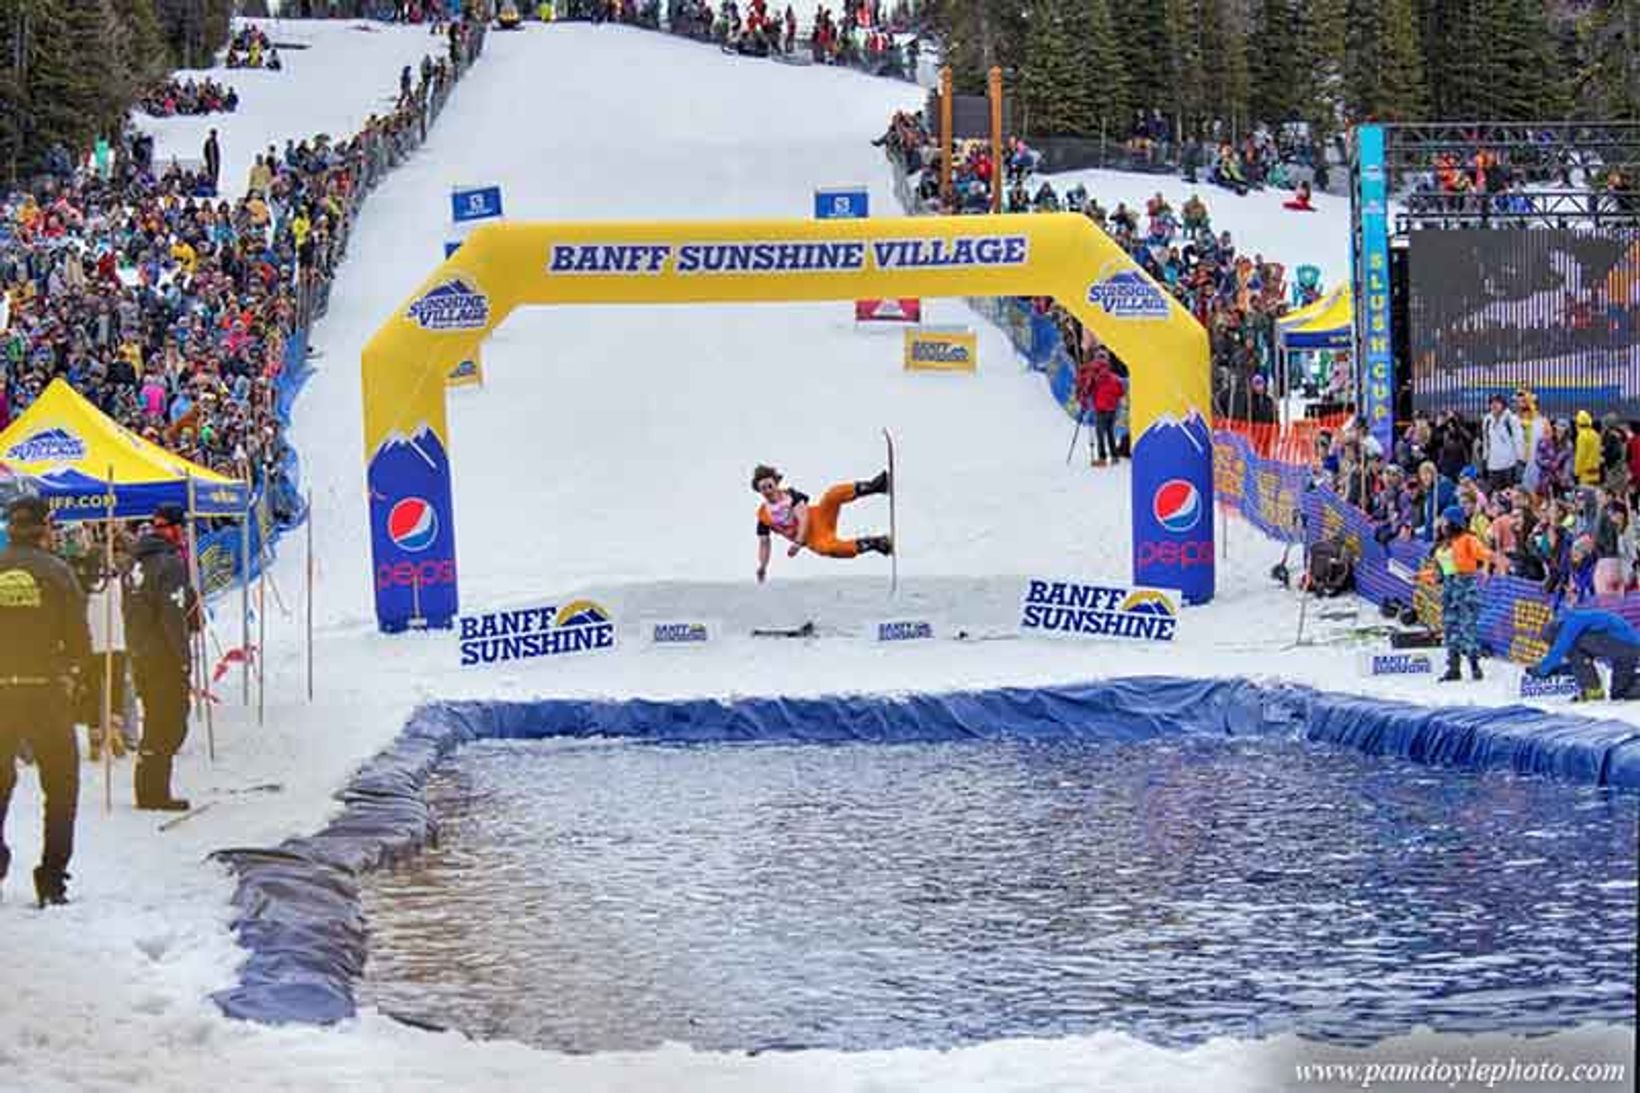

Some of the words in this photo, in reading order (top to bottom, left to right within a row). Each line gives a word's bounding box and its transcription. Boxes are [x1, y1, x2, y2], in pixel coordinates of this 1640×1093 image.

[550, 245, 672, 273] BANFF
[677, 241, 866, 271] SUNSHINE
[874, 237, 1027, 267] VILLAGE
[419, 308, 488, 326] VILLAGE
[1370, 253, 1387, 353] SLUSH
[1372, 362, 1388, 419] CUP
[1027, 581, 1126, 609] BANFF
[461, 608, 557, 640] BANFF
[1022, 607, 1176, 641] SUNSHINE
[461, 626, 614, 665] SUNSHINE
